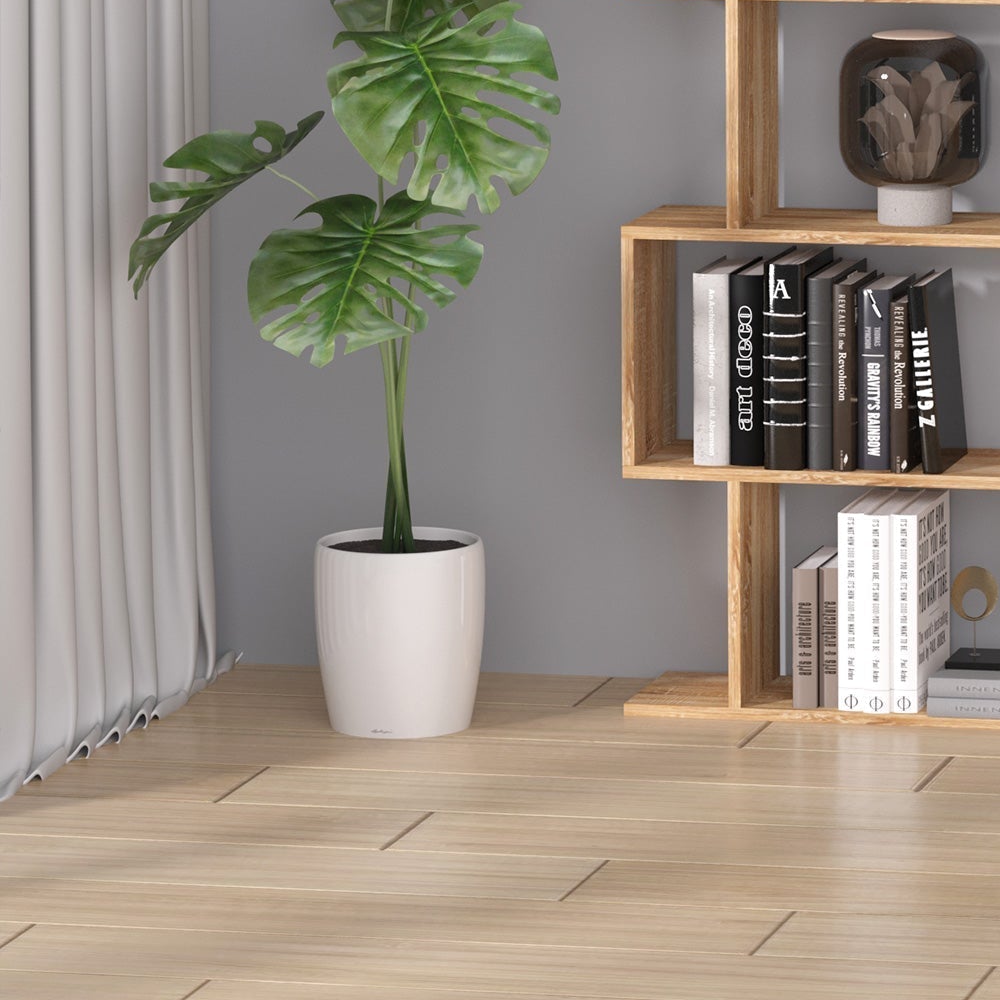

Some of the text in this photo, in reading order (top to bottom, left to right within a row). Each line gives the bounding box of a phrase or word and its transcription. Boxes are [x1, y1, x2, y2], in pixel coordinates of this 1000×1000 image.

[773, 280, 791, 299] A
[737, 306, 753, 431] art deco
[838, 294, 847, 401] REVEALING the Revolution
[894, 307, 906, 409] REVEALING the Revolution
[867, 362, 881, 457] GRAVITY'S RAINBOW
[919, 415, 936, 428] Z
[795, 602, 812, 648] architecture
[822, 601, 837, 647] architecture
[797, 661, 812, 676] arts
[823, 660, 837, 675] arts
